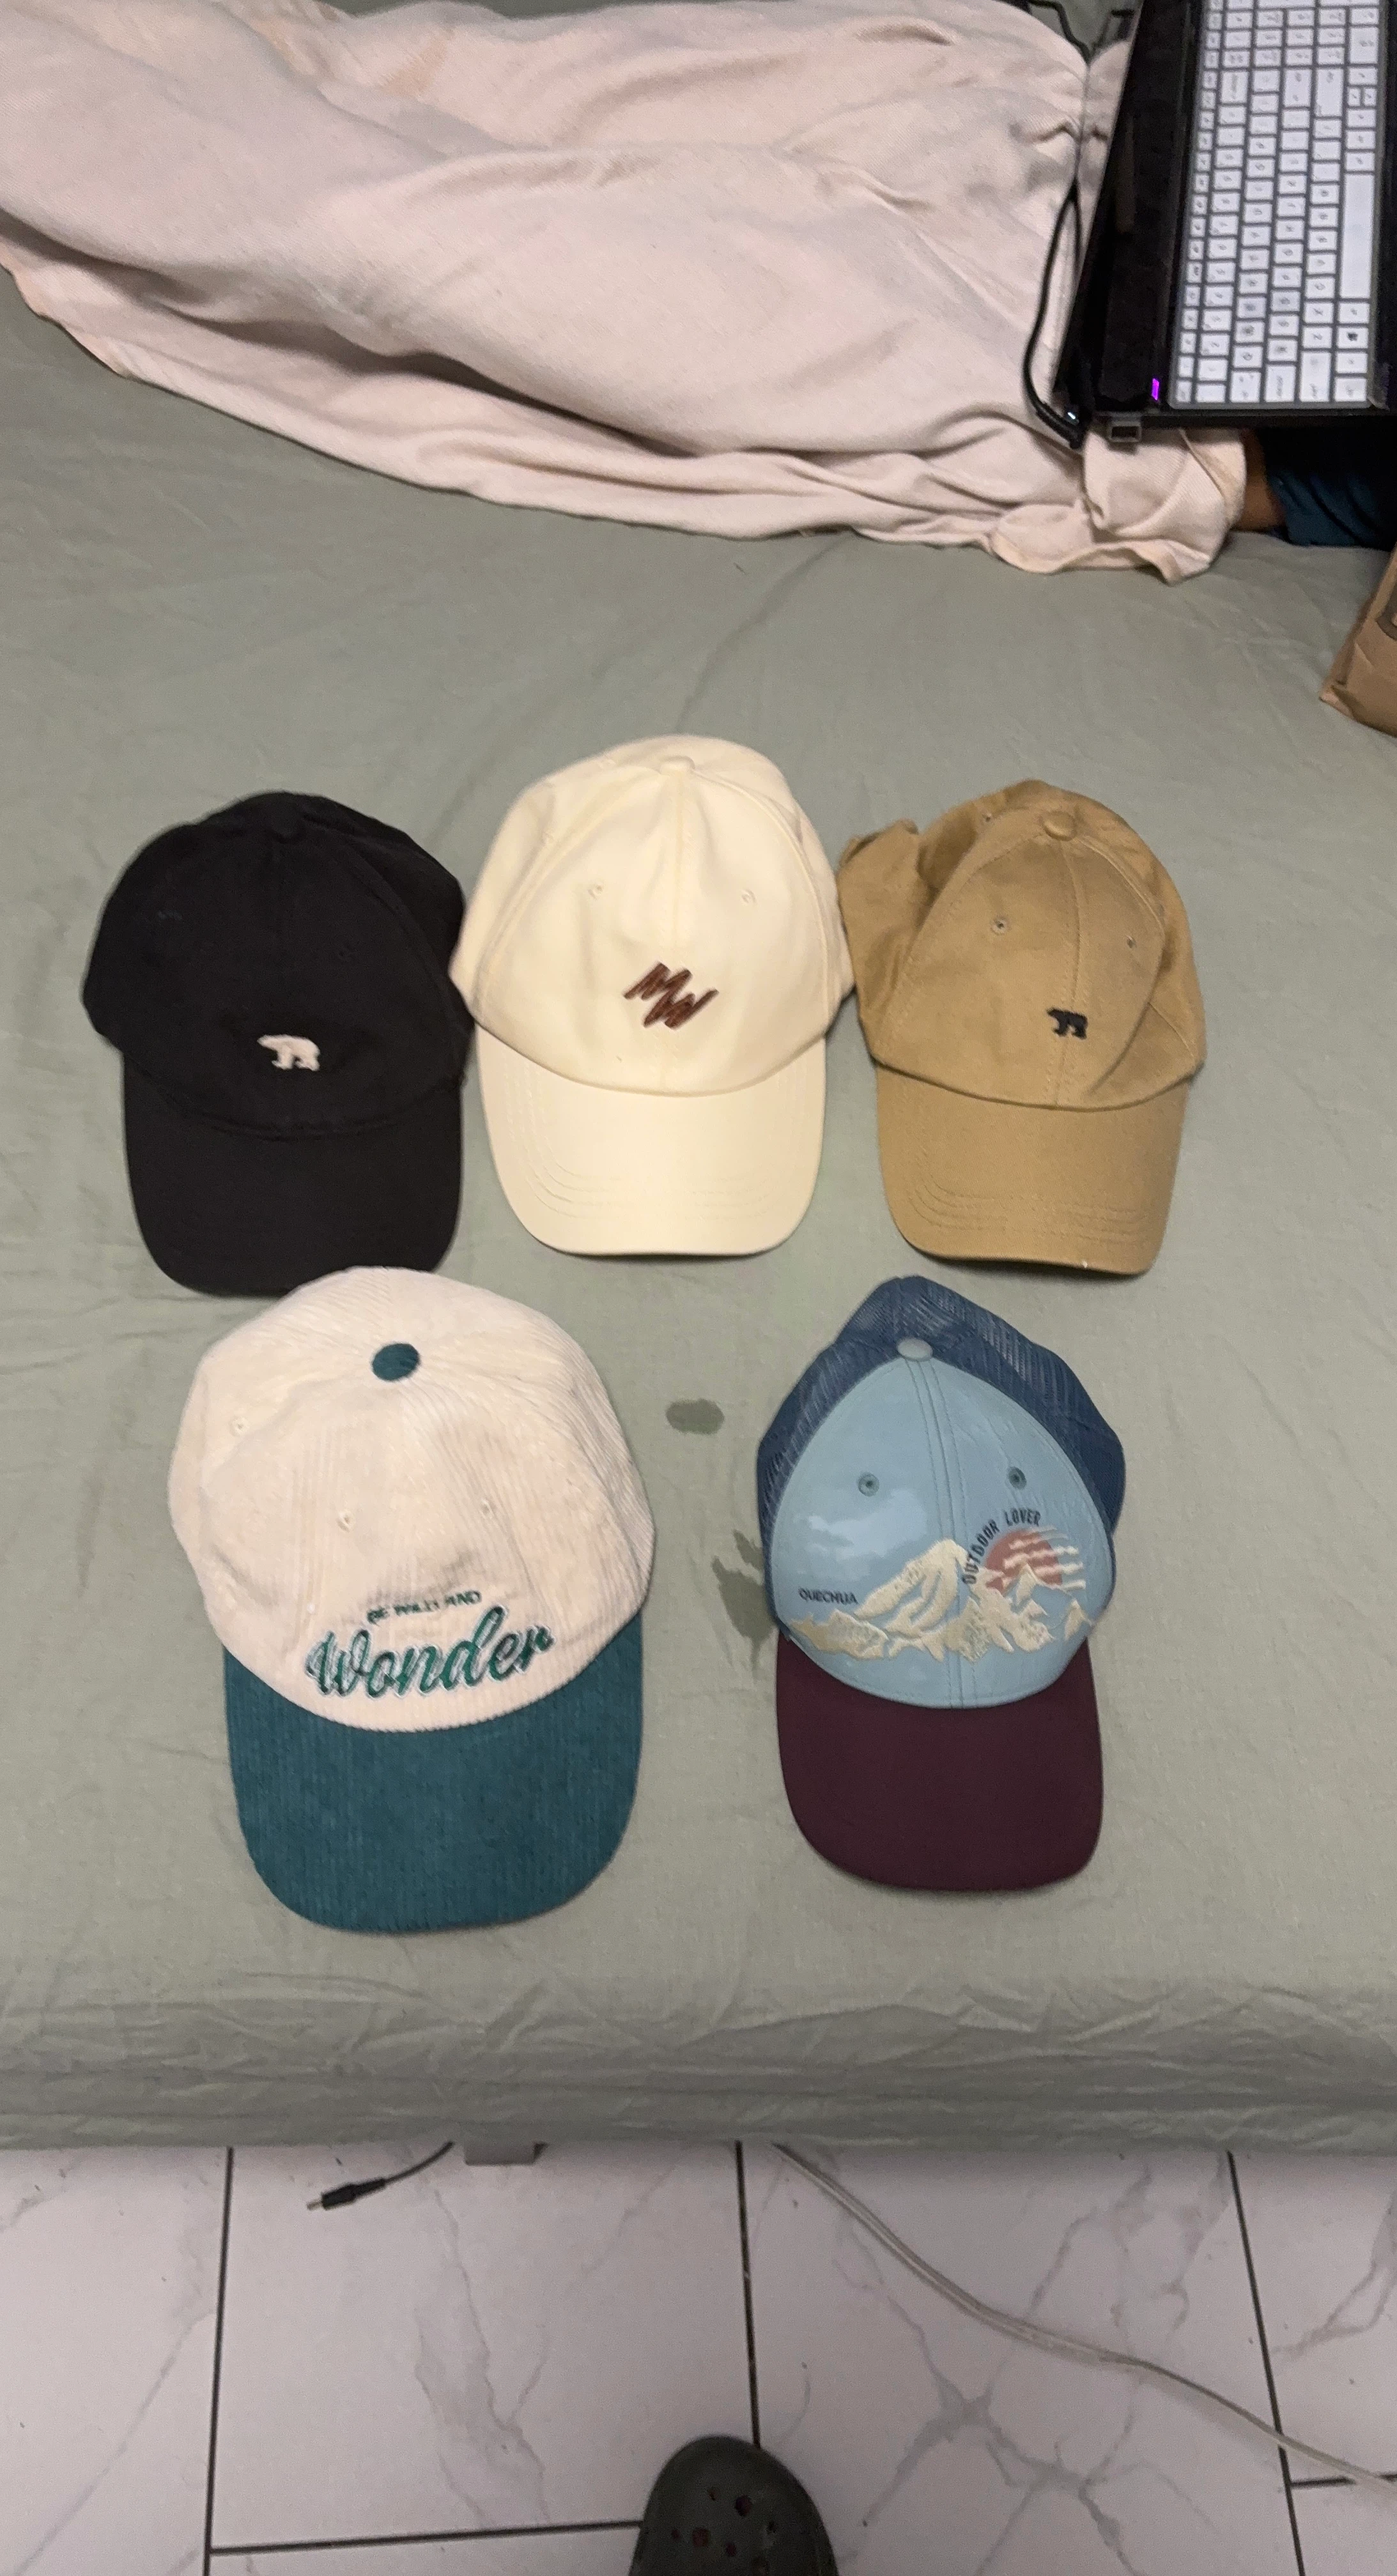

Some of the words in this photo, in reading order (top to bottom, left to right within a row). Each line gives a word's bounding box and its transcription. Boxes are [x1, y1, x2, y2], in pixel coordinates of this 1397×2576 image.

[961, 1519, 1000, 1584] OUTDOOR
[1003, 1508, 1040, 1527] LOVER
[444, 1590, 482, 1607] AND
[798, 1588, 858, 1605] QUECHUA
[305, 1605, 555, 1698] Wonder
